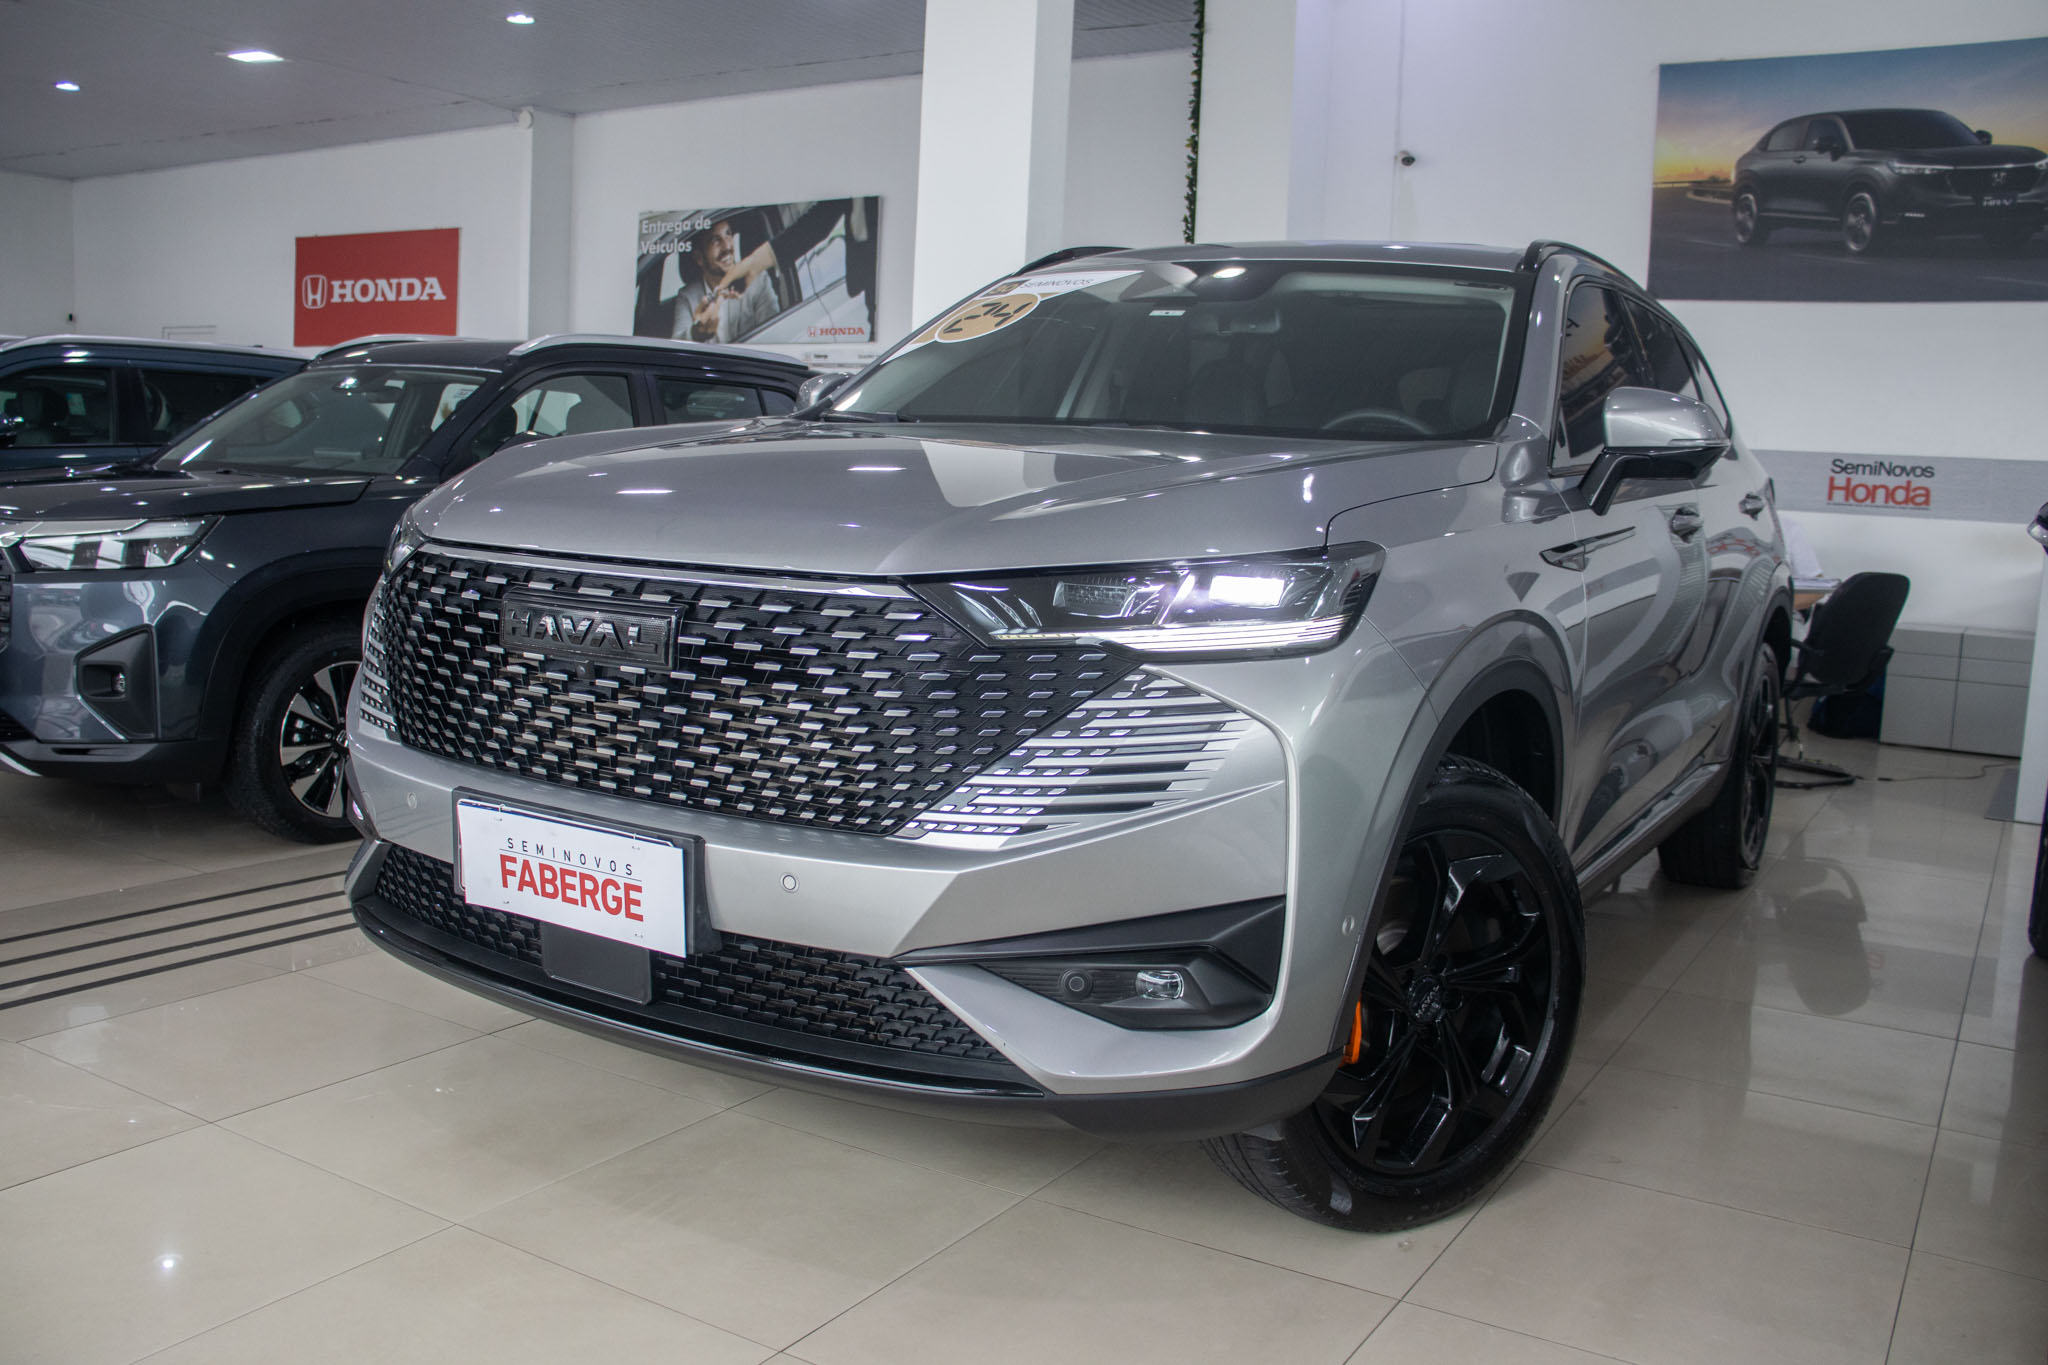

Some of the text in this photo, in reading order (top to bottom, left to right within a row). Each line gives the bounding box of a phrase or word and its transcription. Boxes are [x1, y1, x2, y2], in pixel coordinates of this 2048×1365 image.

[641, 216, 712, 235] Entrega de
[331, 276, 447, 303] HONDA
[820, 327, 865, 336] HONDA
[1831, 458, 1935, 479] SemiNovos
[1827, 476, 1931, 506] Honda
[509, 609, 657, 654] HAVAL
[507, 837, 634, 876] SEMINOVOS
[499, 853, 644, 922] FABERGE
